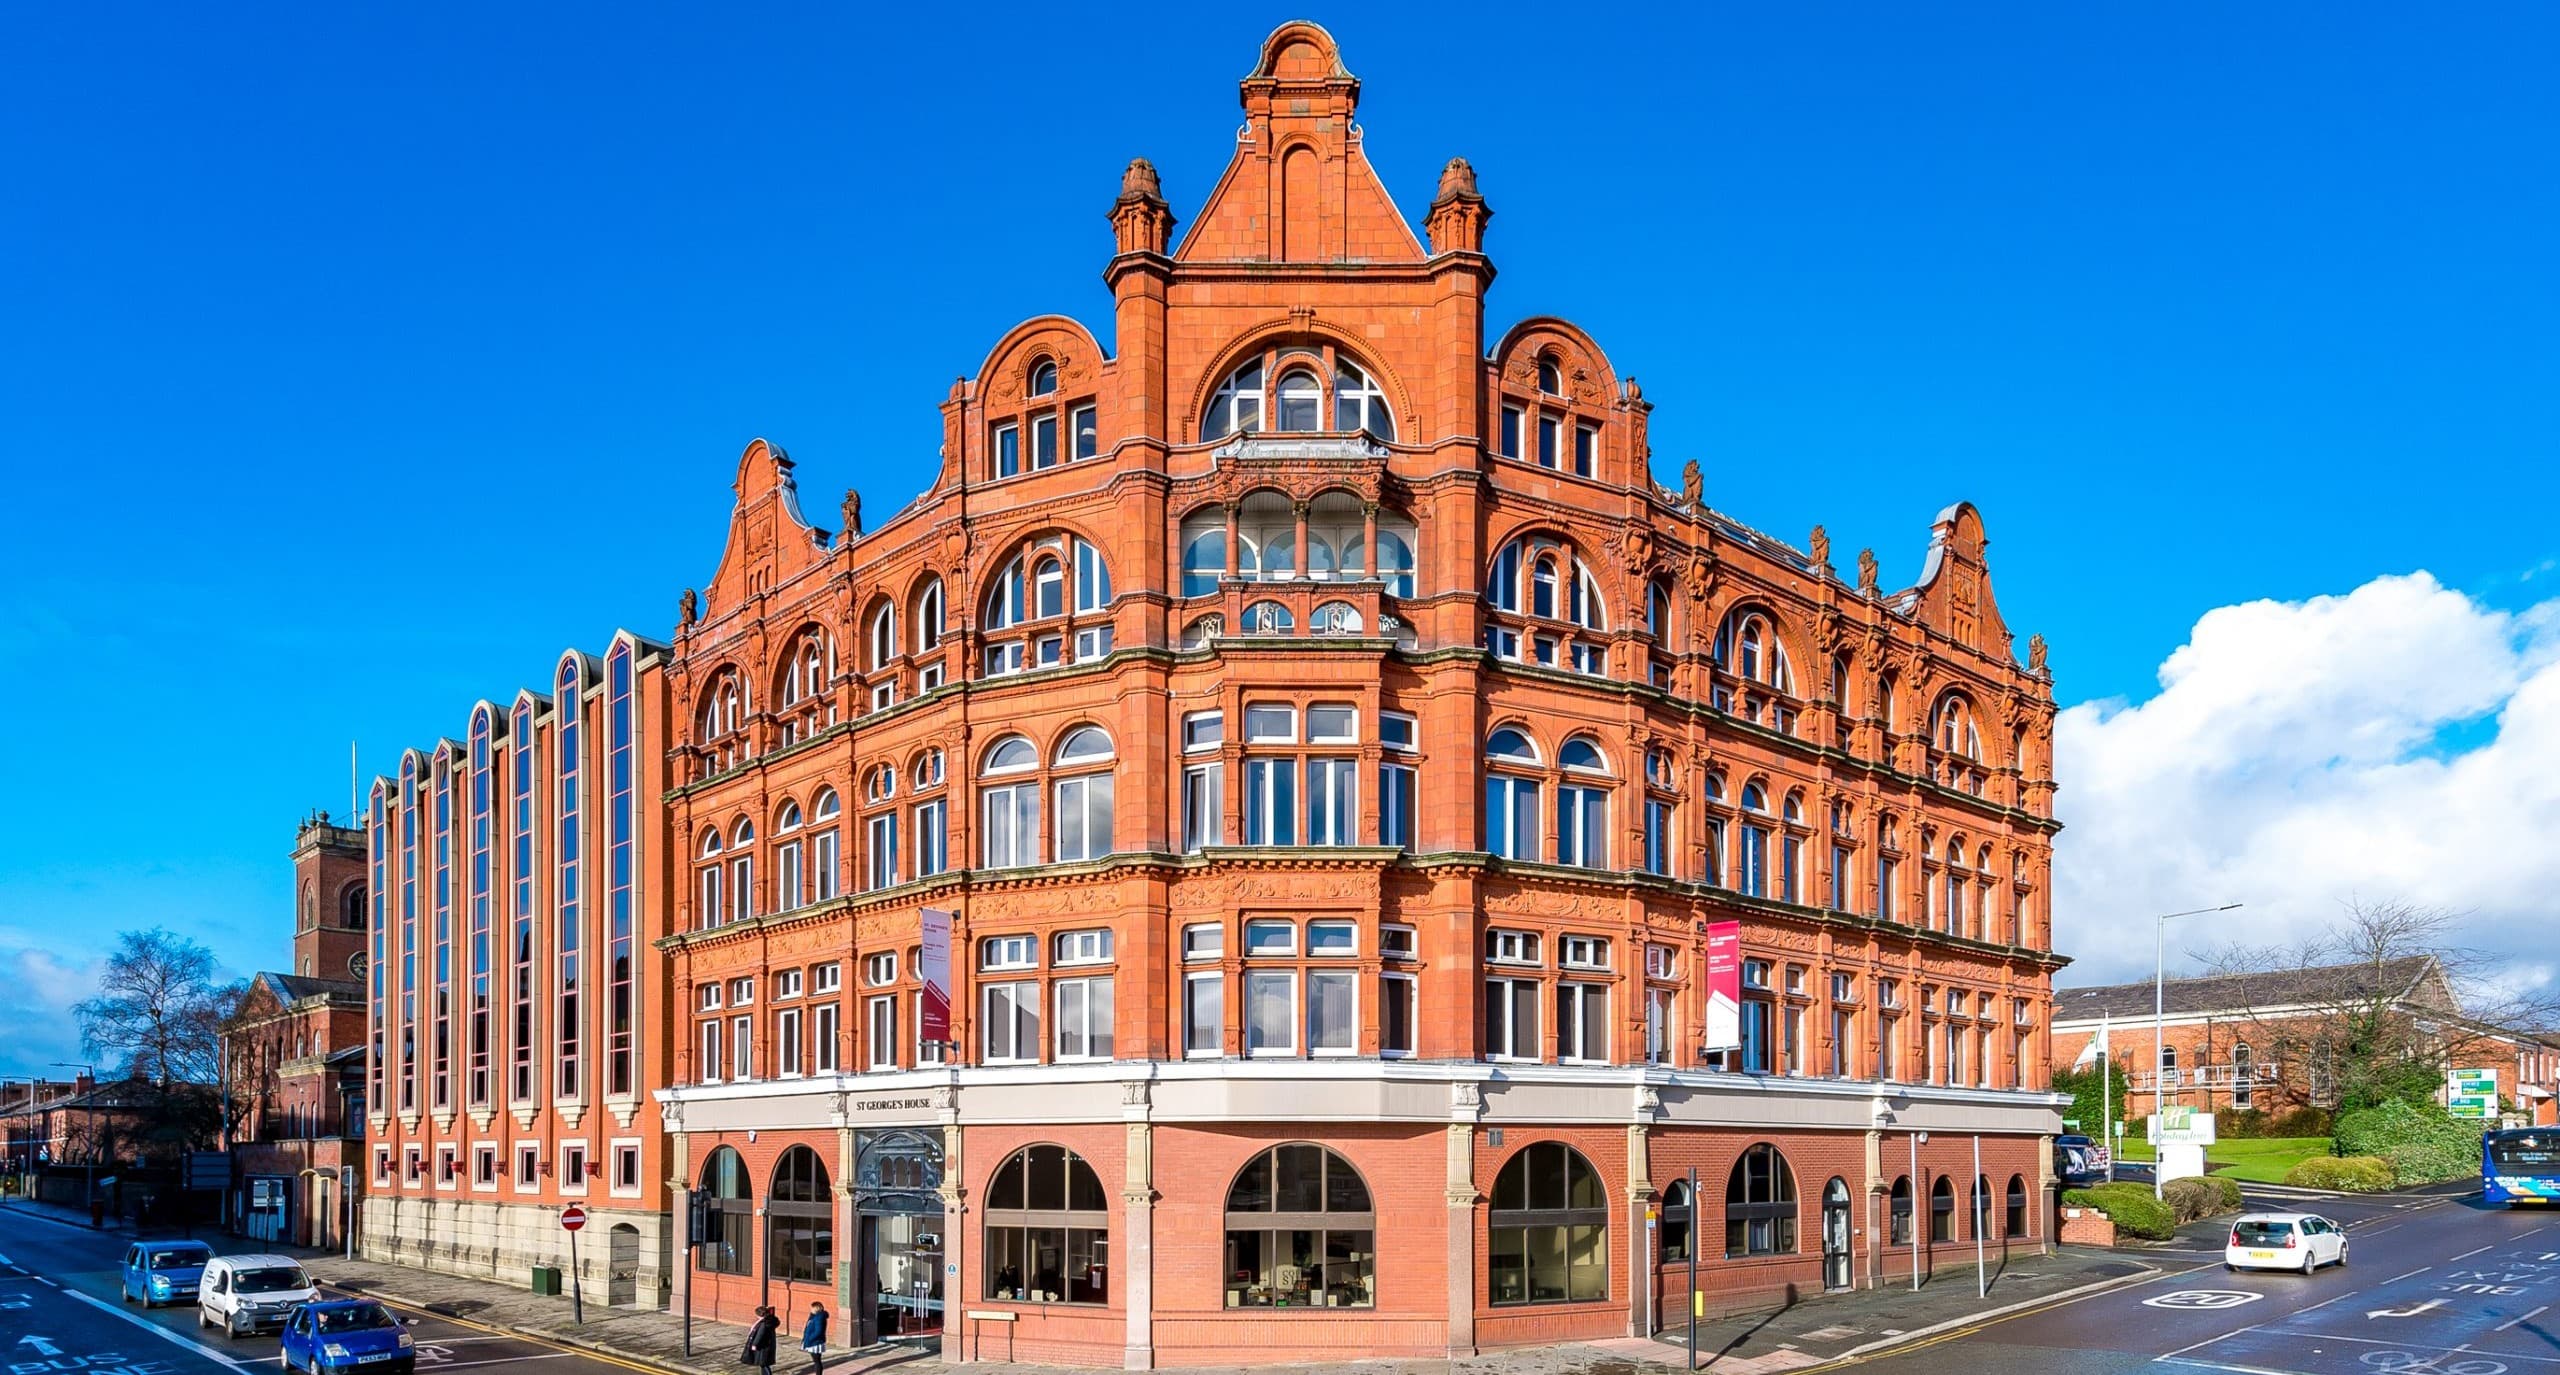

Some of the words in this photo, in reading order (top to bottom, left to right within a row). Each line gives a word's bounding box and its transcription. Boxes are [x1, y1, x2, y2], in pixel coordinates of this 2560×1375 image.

[856, 1101, 866, 1111] ST
[866, 1100, 904, 1110] GEORGE'S
[904, 1098, 931, 1109] HOUSE
[2502, 1152, 2508, 1161] 1
[2430, 1283, 2530, 1296] BUS
[2161, 1293, 2244, 1306] 20
[8, 1352, 128, 1375] BUS
